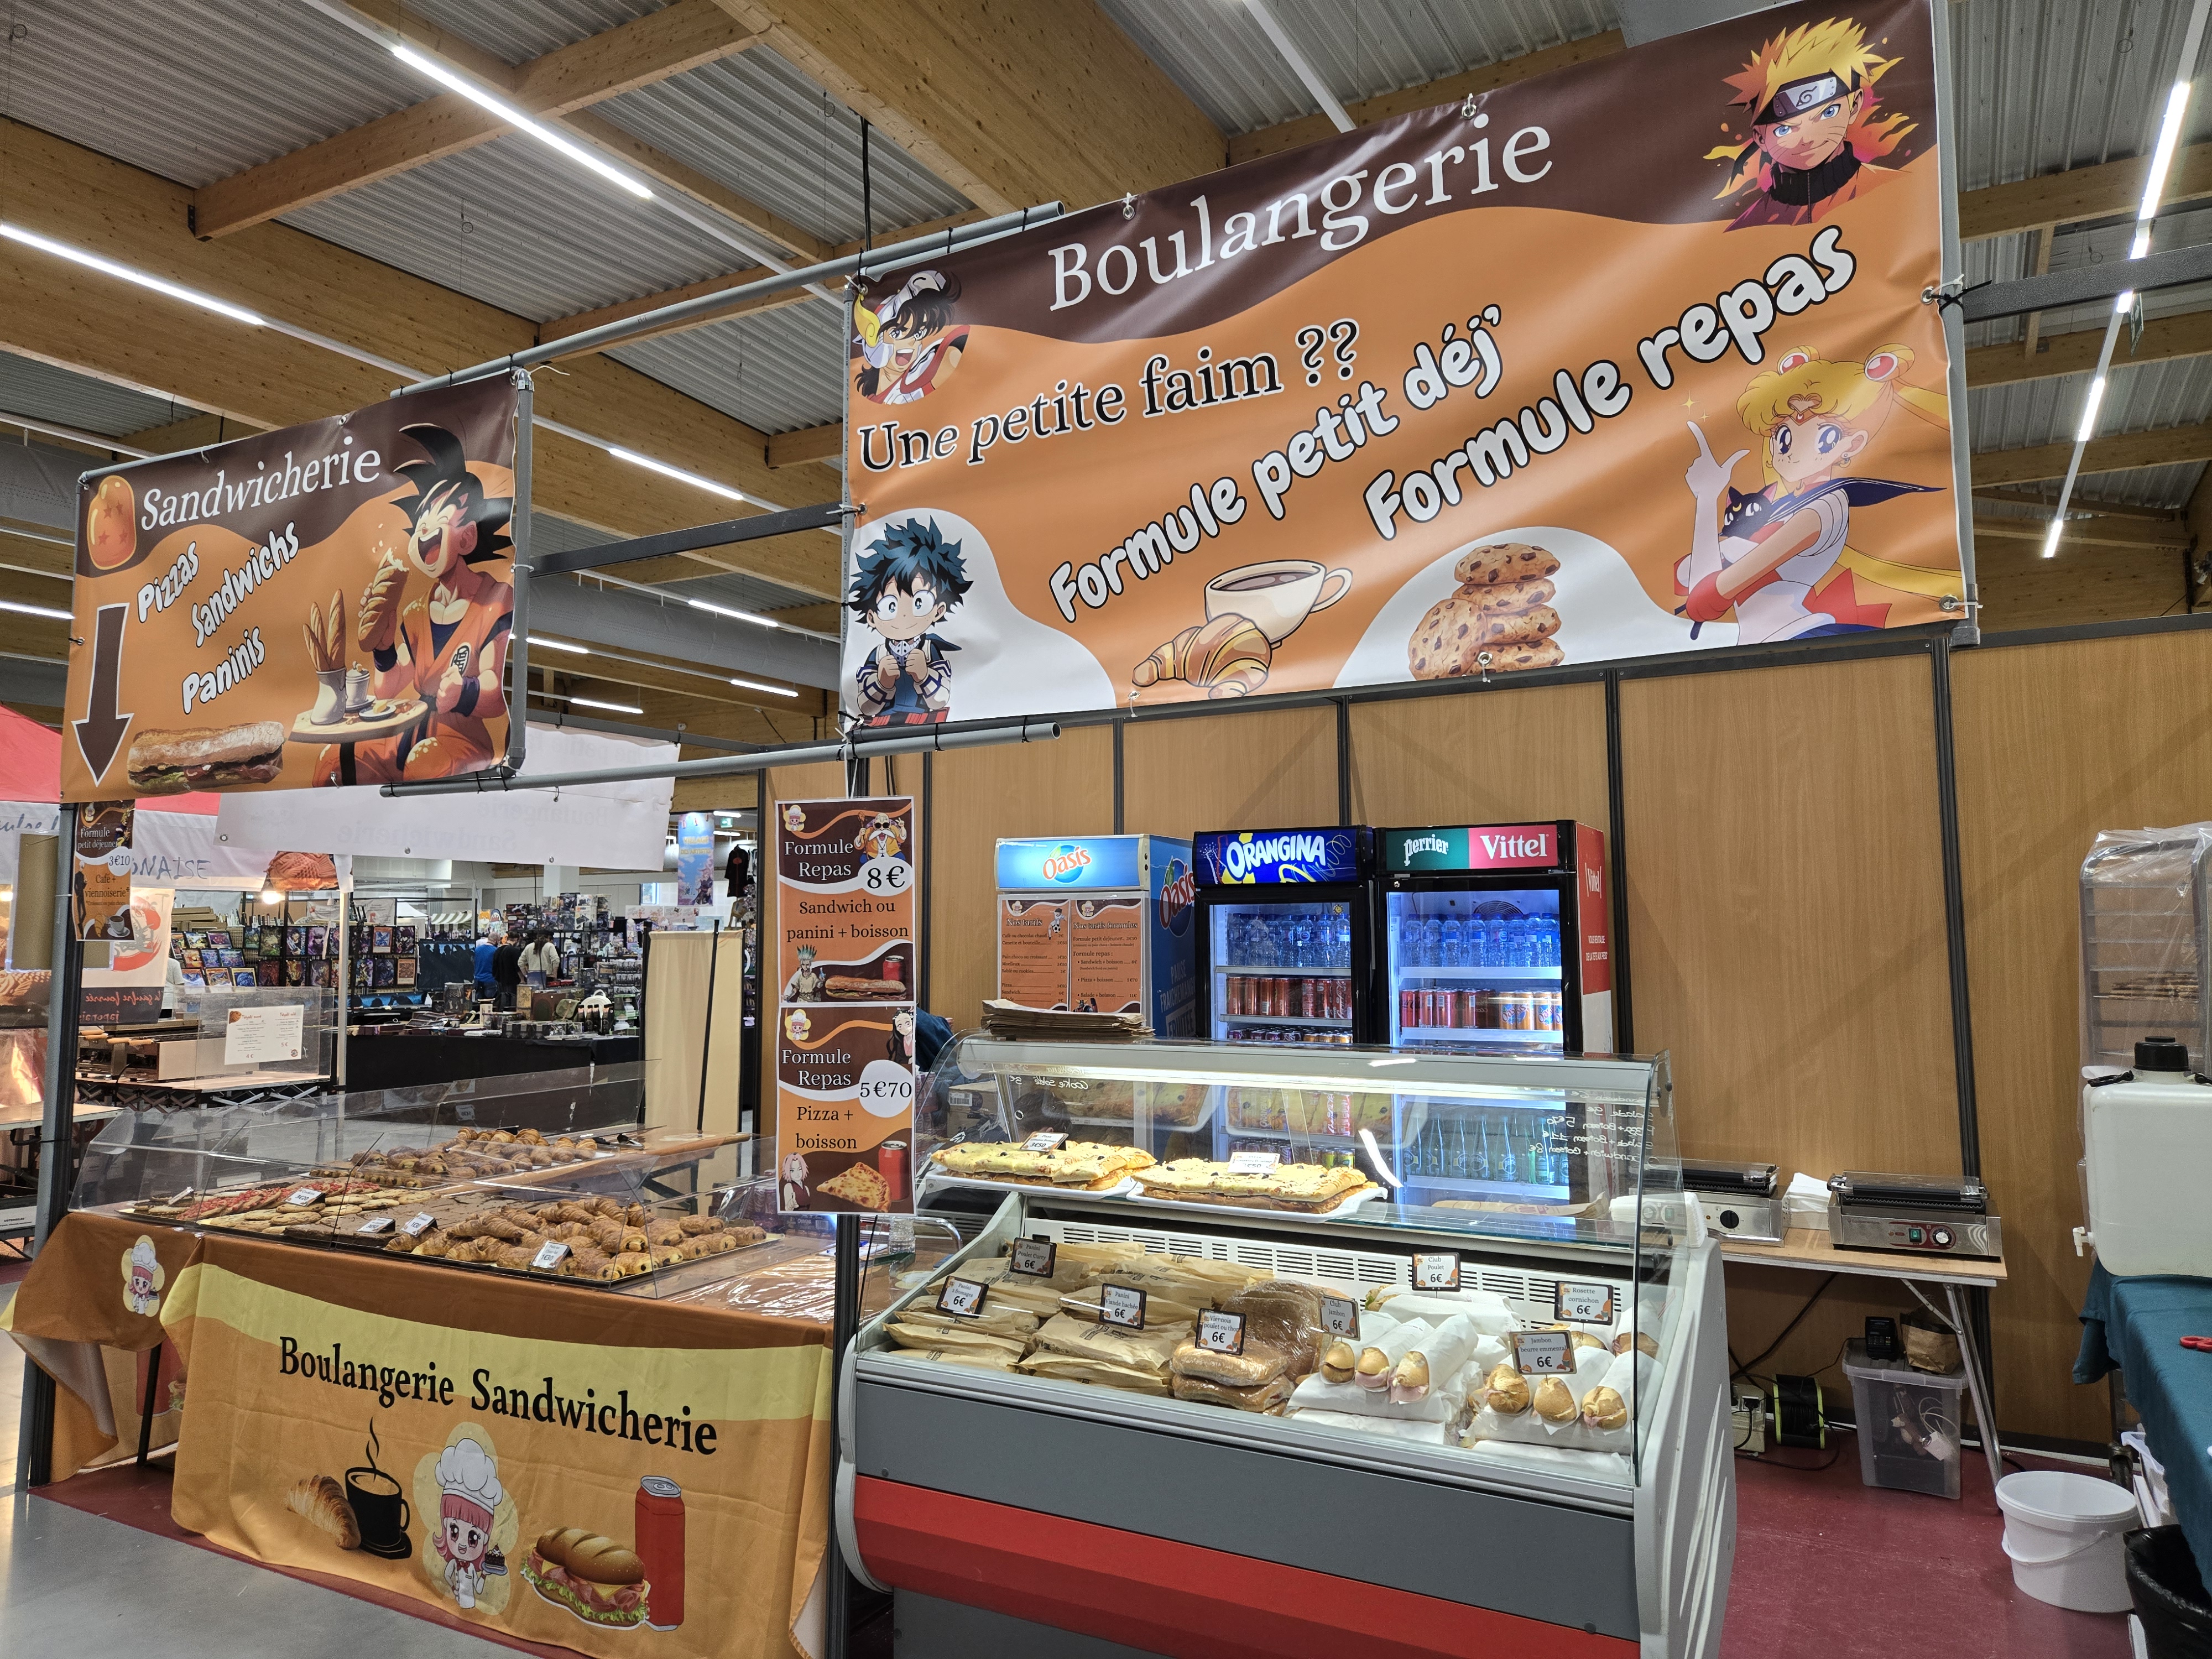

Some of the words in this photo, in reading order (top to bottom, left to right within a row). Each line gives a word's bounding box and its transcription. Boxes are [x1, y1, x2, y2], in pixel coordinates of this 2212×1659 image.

[1047, 114, 1553, 312] Boulangerie
[1363, 358, 1632, 541] Formule
[1637, 225, 1857, 390] repas
[858, 421, 958, 474] Une
[967, 379, 1125, 465] petite
[1141, 345, 1281, 420] faim
[1295, 317, 1359, 389] ??
[141, 436, 380, 530] Sandwicherie
[1048, 477, 1247, 623] Formule
[1251, 380, 1400, 520] petit
[137, 541, 199, 623] Pizzas
[191, 520, 300, 648] Sandwichs
[182, 626, 265, 715] Paninis
[80, 826, 110, 838] Formule
[77, 841, 92, 851] petit
[92, 839, 118, 850] déjeuner
[784, 839, 854, 855] Formule
[1480, 833, 1547, 860] Vittel
[108, 855, 130, 866] 3€10
[1042, 846, 1092, 880] Oasis
[1226, 834, 1326, 878] ORANGINA
[95, 873, 111, 884] Café
[798, 862, 852, 880] Repas
[1587, 868, 1600, 893] Vittel
[1159, 863, 1195, 930] Oasis
[799, 899, 872, 915] Sandwich
[876, 901, 896, 912] ou
[786, 925, 834, 943] panini
[838, 928, 848, 938] +
[851, 924, 909, 938] boisson
[781, 1048, 852, 1065] Formule
[798, 1070, 852, 1090] Repas
[860, 1081, 912, 1098] 5€70
[797, 1105, 839, 1121] Pizza
[844, 1110, 854, 1120] +
[795, 1133, 857, 1149] boisson
[1025, 1260, 1035, 1269] 6€
[1430, 1274, 1442, 1283] 6€
[954, 1288, 973, 1297] fromages
[953, 1296, 966, 1307] 6€
[1105, 1298, 1121, 1307] Viande
[1121, 1301, 1138, 1310] hachée
[1114, 1308, 1125, 1318] 6€
[1328, 1308, 1345, 1317] Jambon
[1577, 1305, 1591, 1315] 6€
[1210, 1315, 1232, 1323] Viennois
[1333, 1319, 1343, 1331] 6€
[1212, 1331, 1225, 1343] 6€
[1537, 1356, 1553, 1368] 6€
[279, 1336, 454, 1408] Boulangerie
[471, 1368, 717, 1456] Sandwicherie
